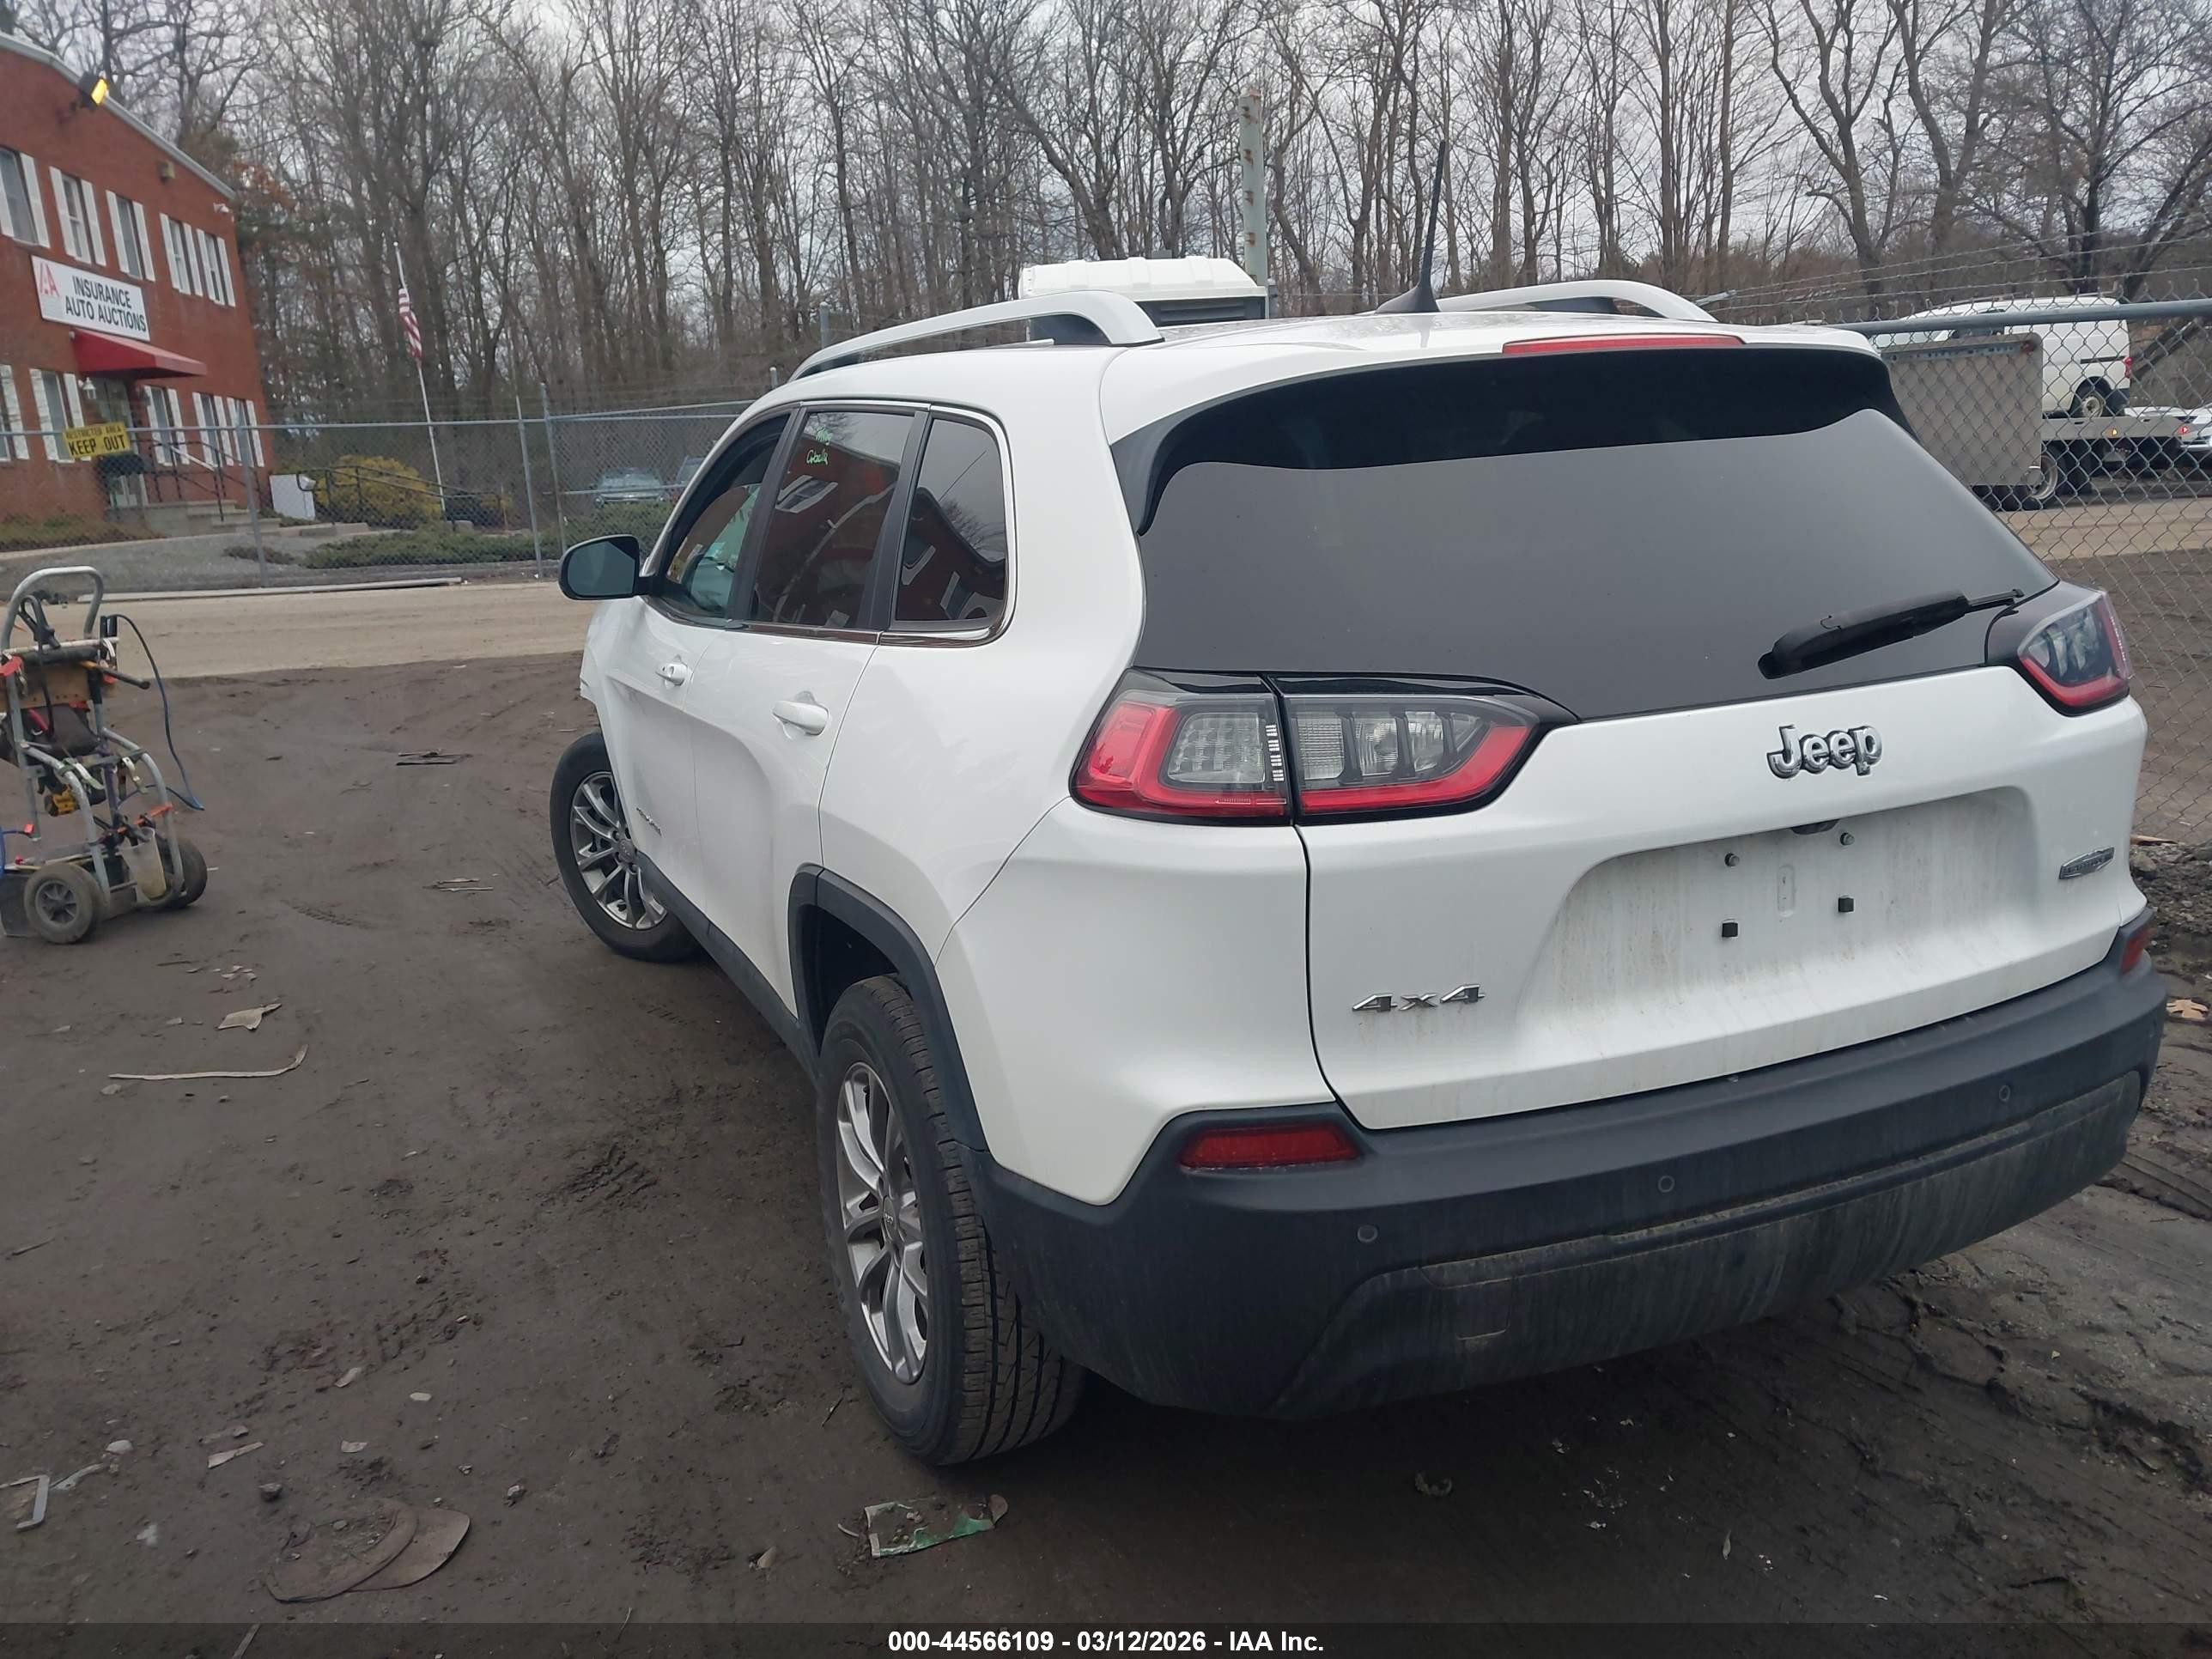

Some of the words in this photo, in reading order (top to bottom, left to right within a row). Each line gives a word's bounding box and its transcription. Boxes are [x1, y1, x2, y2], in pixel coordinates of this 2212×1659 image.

[72, 276, 132, 309] INSURANCE
[65, 295, 94, 320] AUTO
[98, 304, 147, 332] AUCTIONS
[69, 438, 96, 456] KEEP
[103, 434, 125, 451] OUT
[1766, 724, 1883, 779] Jeep
